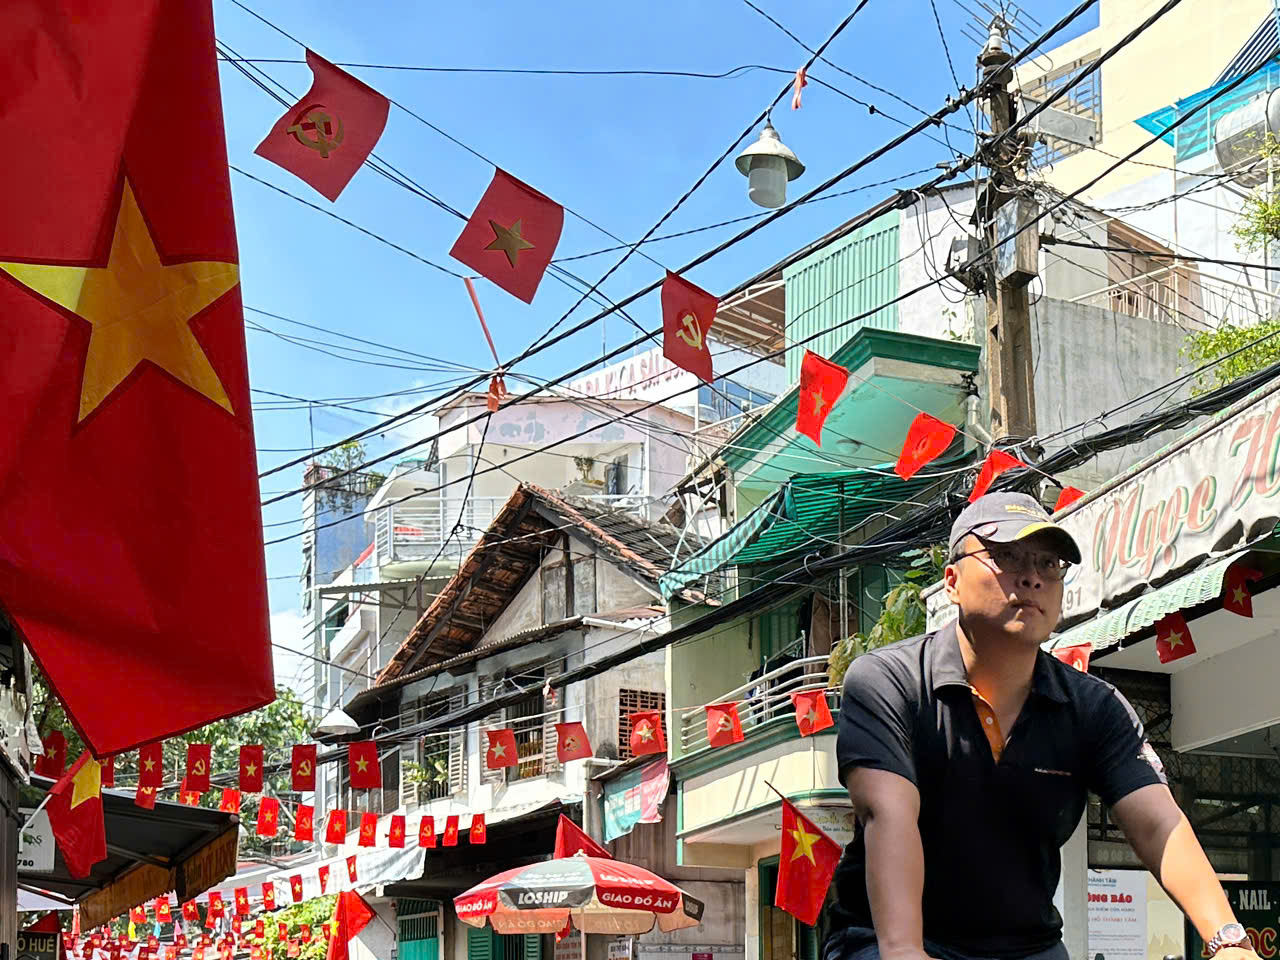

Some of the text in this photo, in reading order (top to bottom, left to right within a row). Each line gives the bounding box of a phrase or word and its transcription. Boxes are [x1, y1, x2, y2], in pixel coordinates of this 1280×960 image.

[1093, 475, 1217, 577] Ngọc
[1066, 587, 1082, 611] 91
[518, 890, 569, 905] LOSHIP
[601, 892, 632, 903] GIAO
[634, 894, 652, 906] ĐỒ
[653, 897, 672, 909] ĂN
[1088, 892, 1133, 903] ÔNG BÁO
[1239, 889, 1271, 910] NAIL
[29, 936, 54, 952] HUẾ
